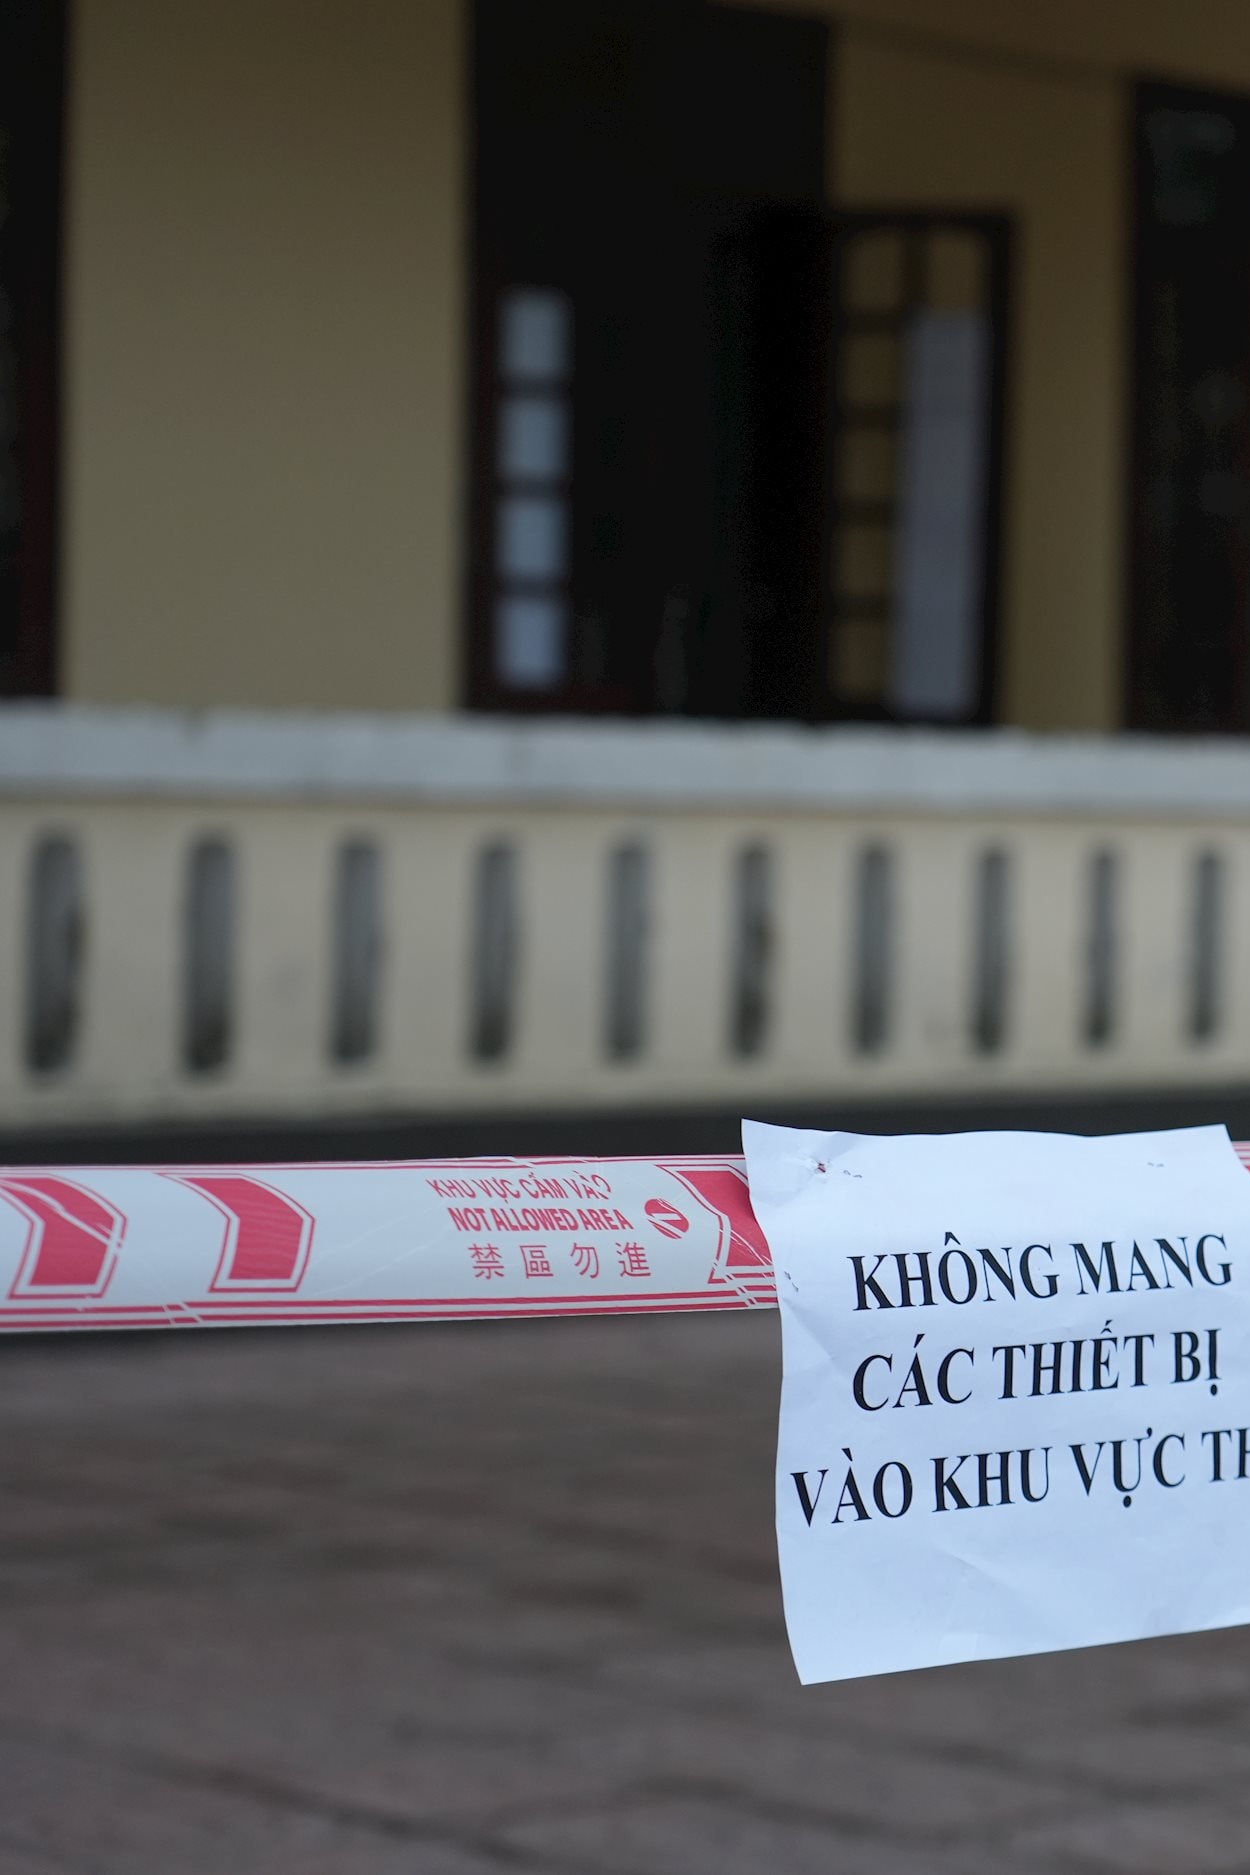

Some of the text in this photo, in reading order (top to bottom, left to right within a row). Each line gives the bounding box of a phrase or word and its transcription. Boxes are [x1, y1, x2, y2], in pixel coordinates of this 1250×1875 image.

[425, 1178, 477, 1199] KHU
[471, 1176, 521, 1204] VỰC
[448, 1206, 634, 1232] NOT ALLOWED AREA
[467, 1241, 651, 1280] 禁區勿進
[846, 1231, 1233, 1312] KHÔNG MANG
[852, 1319, 1222, 1412] CÁC THIẾT BỊ
[790, 1447, 914, 1528] VÀO
[931, 1446, 1053, 1514] KHU
[1068, 1427, 1187, 1509] VỰC
